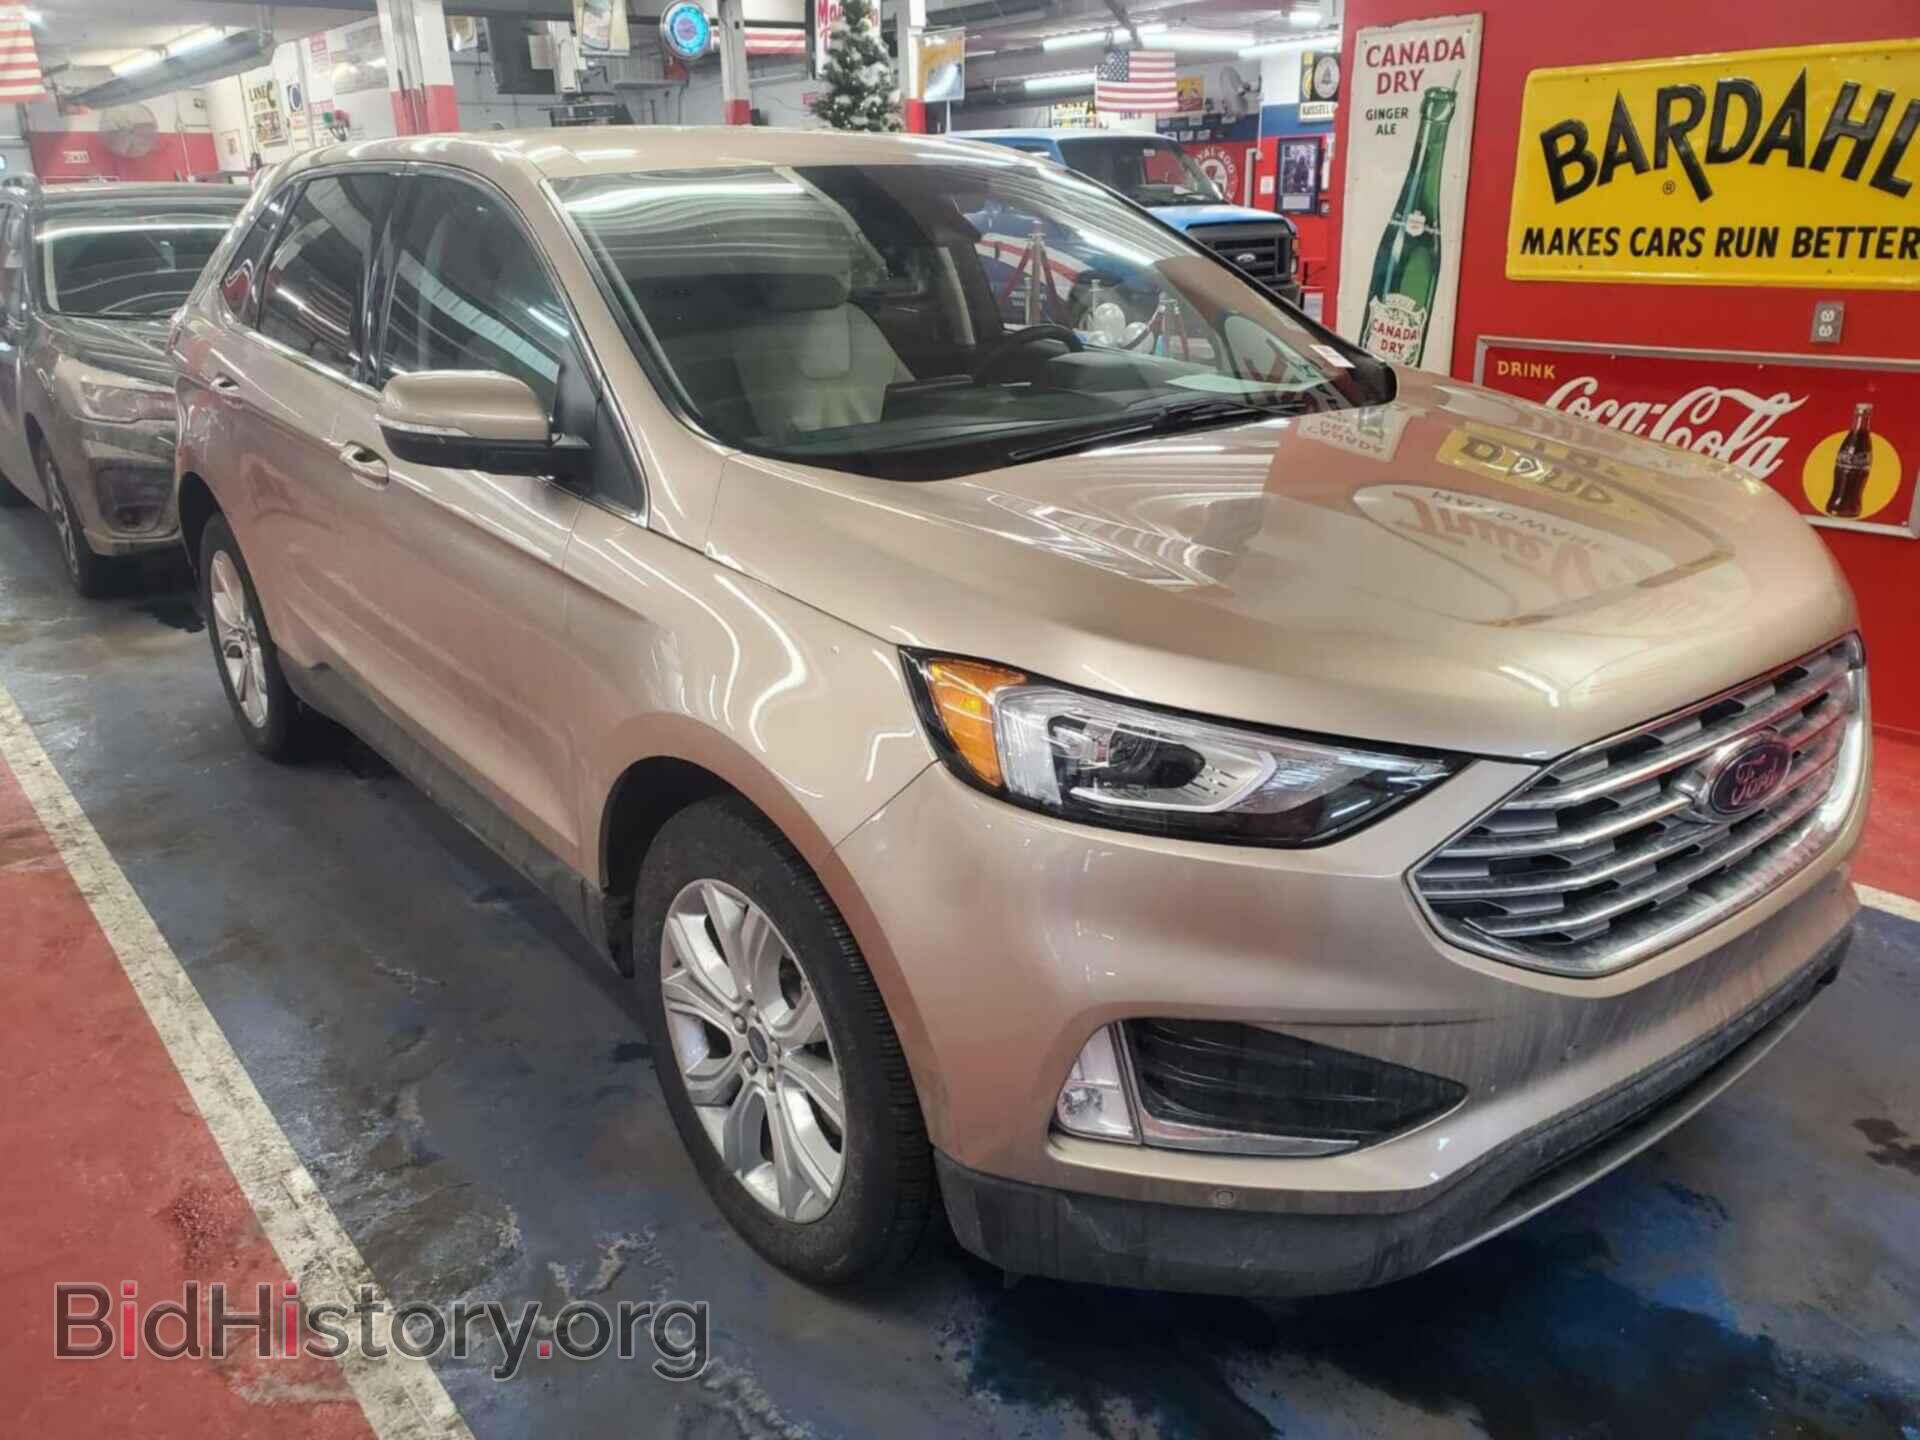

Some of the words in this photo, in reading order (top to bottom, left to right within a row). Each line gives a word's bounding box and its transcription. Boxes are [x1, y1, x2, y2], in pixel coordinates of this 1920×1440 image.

[1366, 37, 1465, 68] CANADA
[1377, 68, 1424, 94] DRY
[1366, 107, 1408, 121] GINGER
[1376, 123, 1396, 136] ALE
[1539, 67, 1920, 204] BARDAHL
[1521, 227, 1619, 257] MAKES
[1629, 227, 1703, 258] CARS
[1714, 227, 1780, 259] RUN
[1791, 226, 1920, 260] BETTER
[1371, 319, 1419, 341] CANADA
[1380, 339, 1405, 355] DRY
[1497, 360, 1556, 380] DRINK
[1731, 753, 1778, 806] Ford
